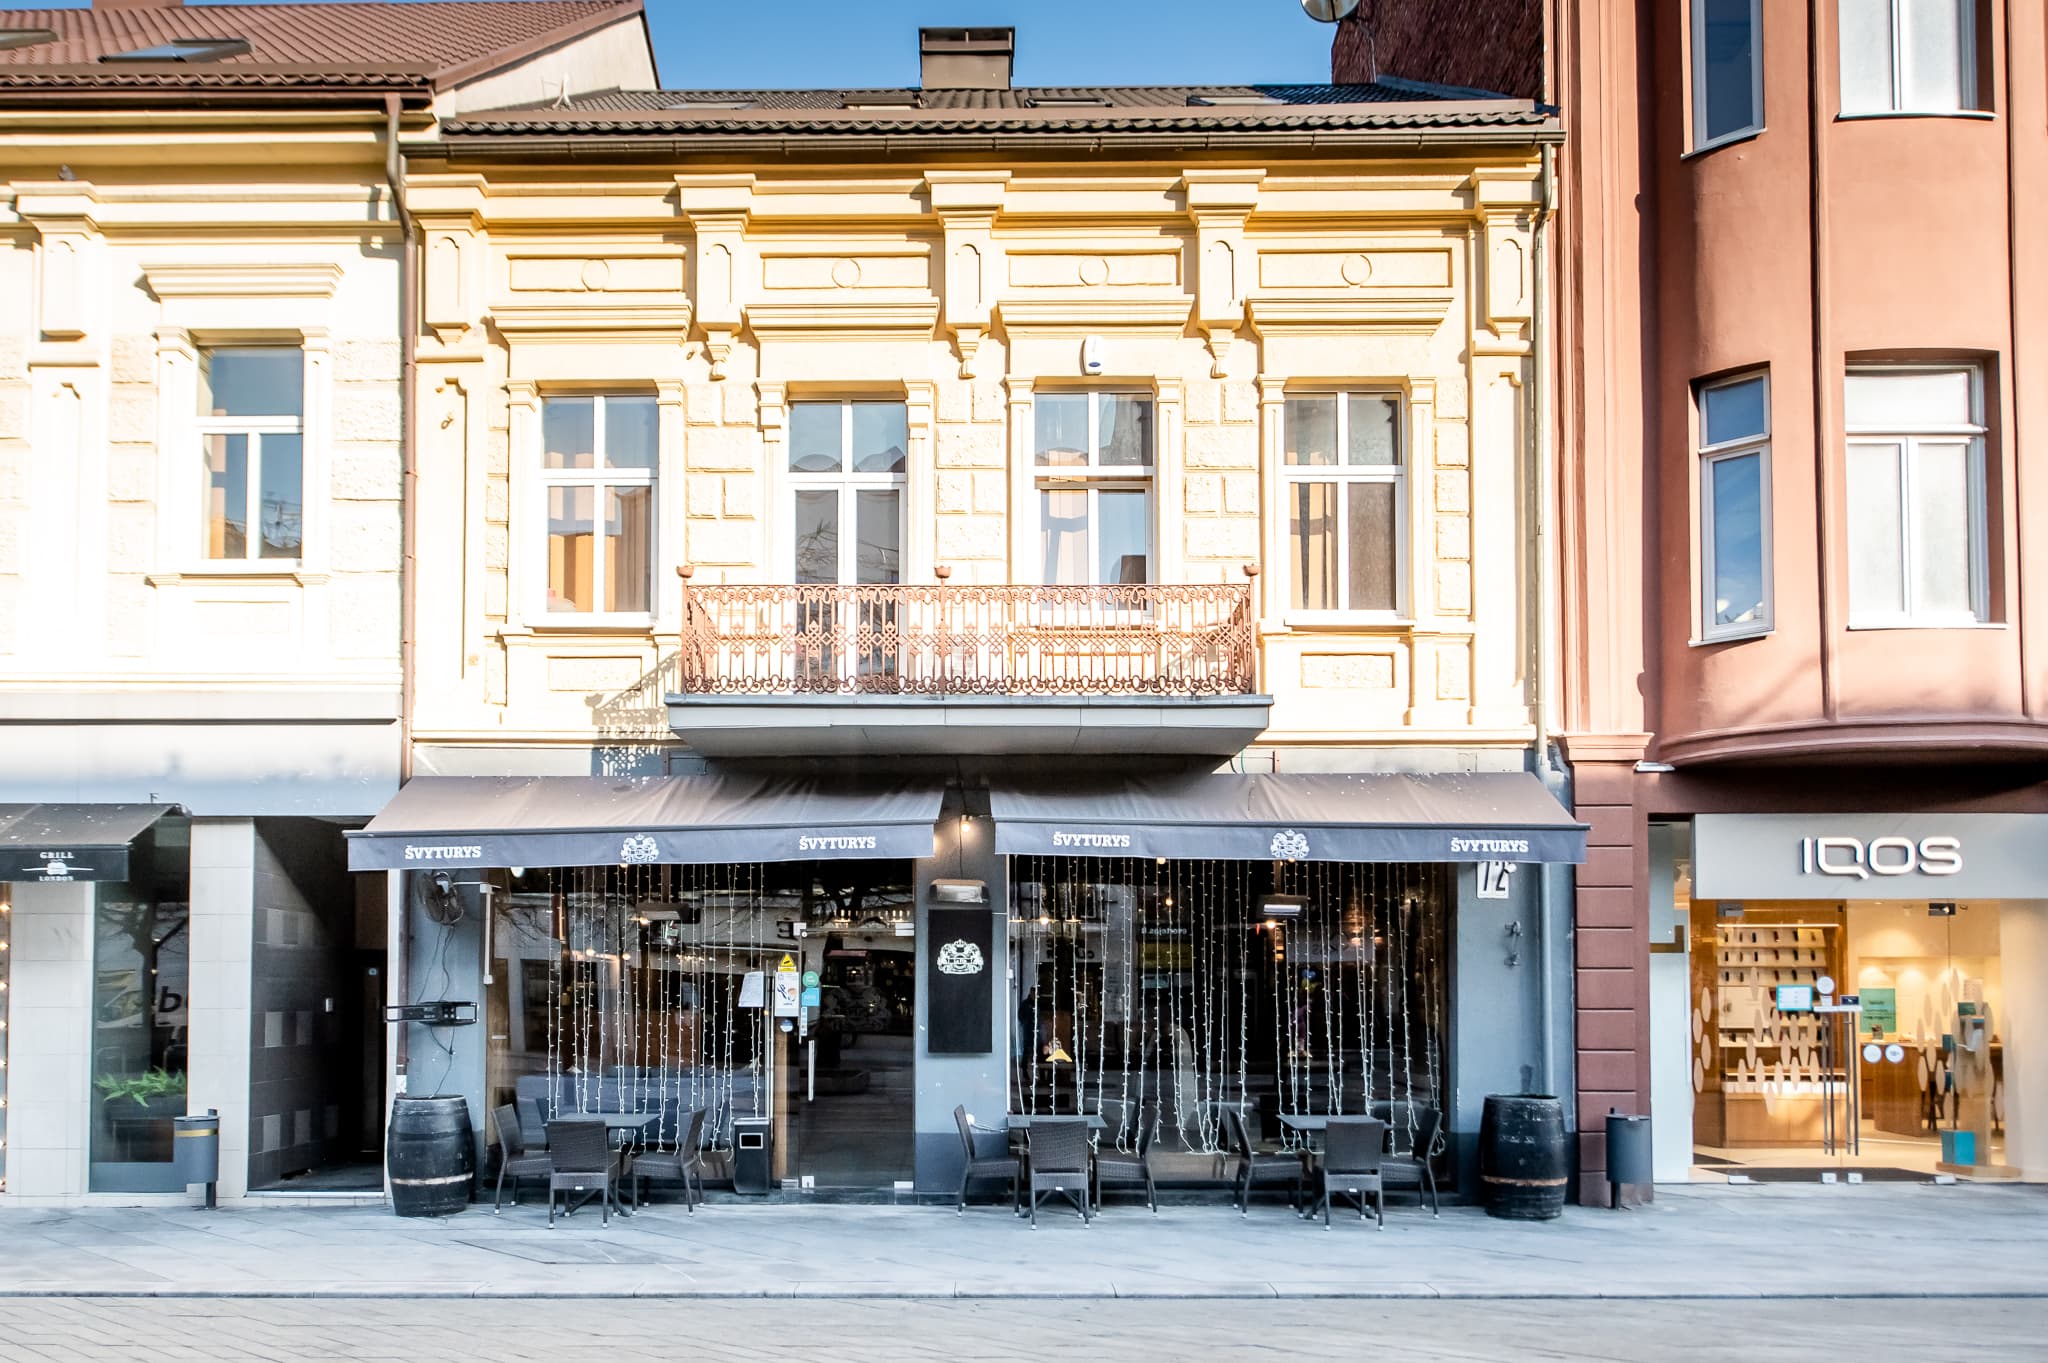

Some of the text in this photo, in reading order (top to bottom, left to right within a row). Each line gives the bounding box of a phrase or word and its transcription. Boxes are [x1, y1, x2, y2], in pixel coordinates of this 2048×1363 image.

[799, 835, 877, 850] ŠVYTURYS
[1053, 831, 1131, 848] ŠVYTURYS
[1450, 837, 1529, 853] ŠVYTURYS
[39, 851, 75, 859] GRILL
[404, 845, 482, 860] ŠVYTURYS
[1802, 836, 1963, 880] IQOS
